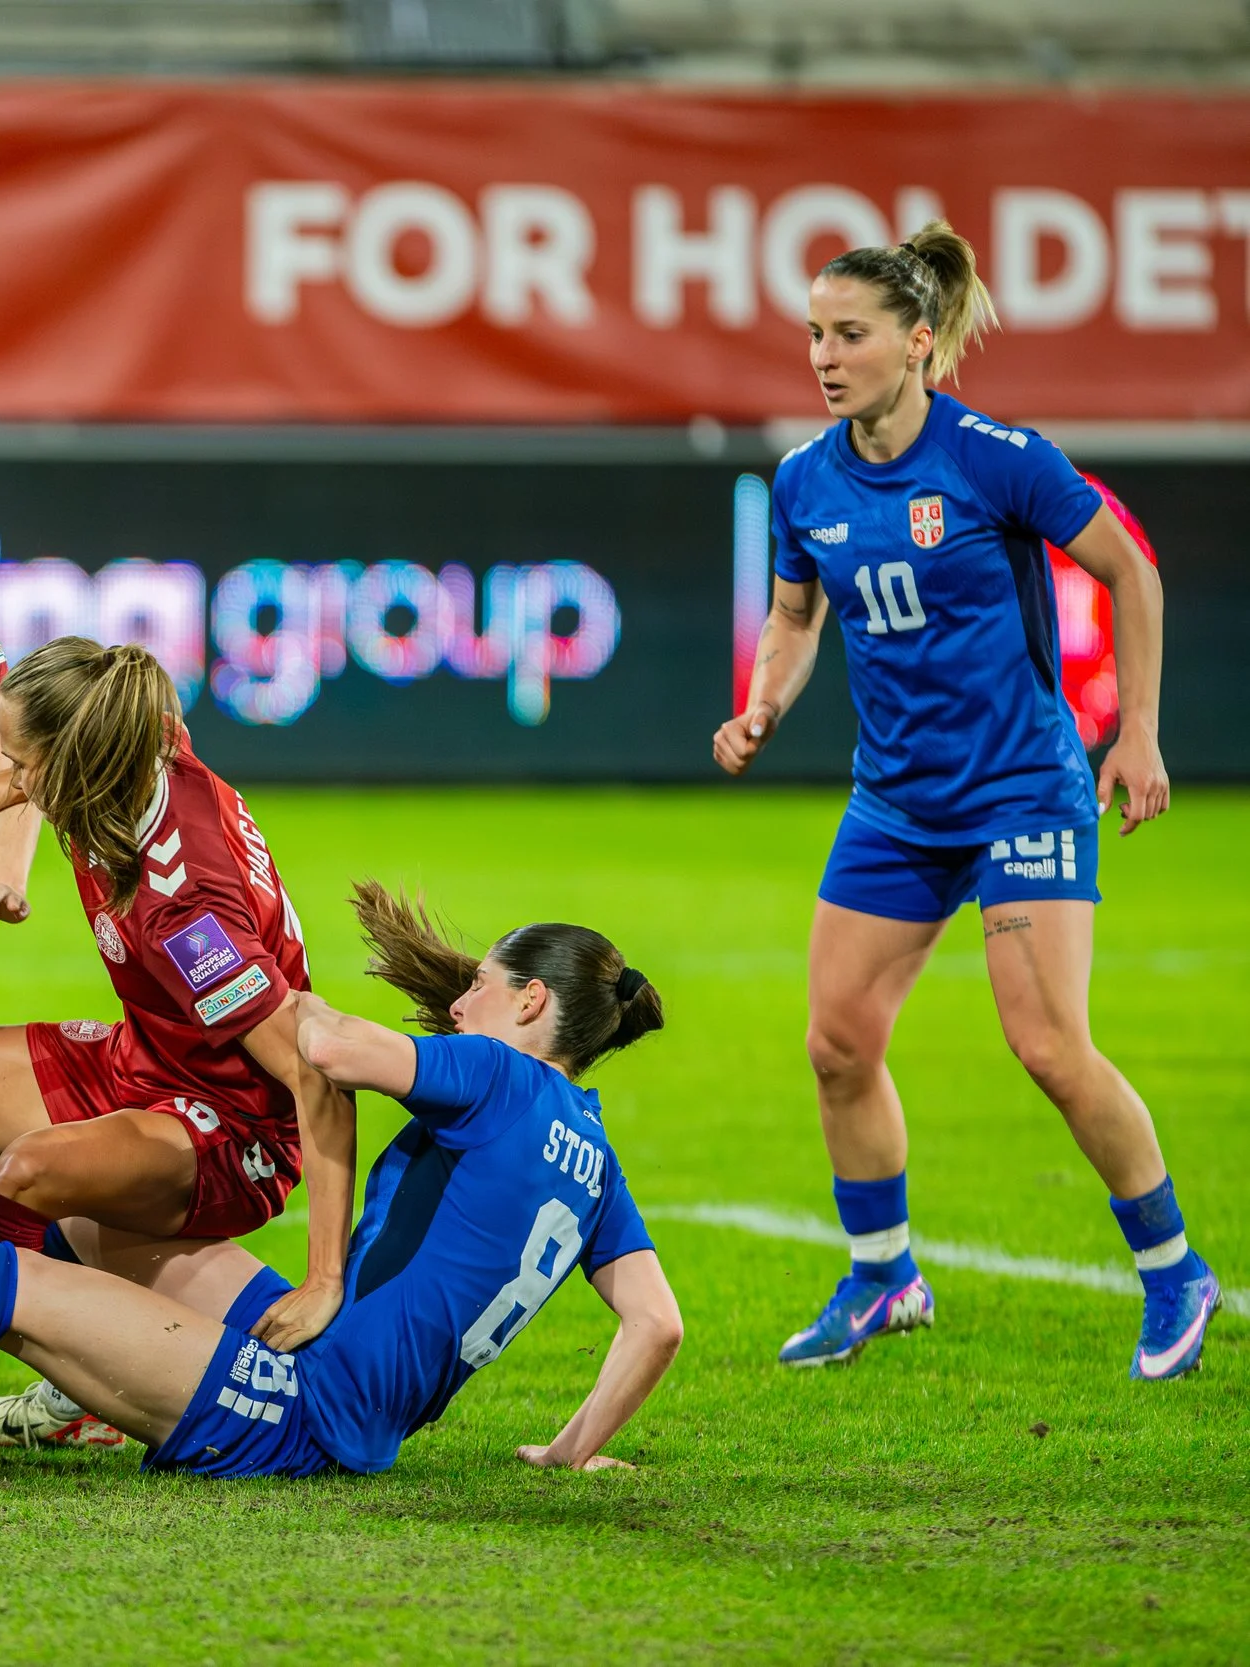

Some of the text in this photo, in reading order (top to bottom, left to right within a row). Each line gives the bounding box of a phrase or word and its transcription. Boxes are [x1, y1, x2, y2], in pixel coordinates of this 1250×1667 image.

[244, 180, 1250, 332] FOR HODE
[810, 522, 849, 541] capelli
[854, 561, 927, 634] 10
[1004, 858, 1056, 879] capelli
[189, 947, 232, 977] EUROPEAN
[192, 953, 236, 983] QUALIFIERS
[200, 972, 263, 1017] FOUNDATION
[461, 1198, 583, 1369] 8
[234, 1339, 259, 1384] capelli
